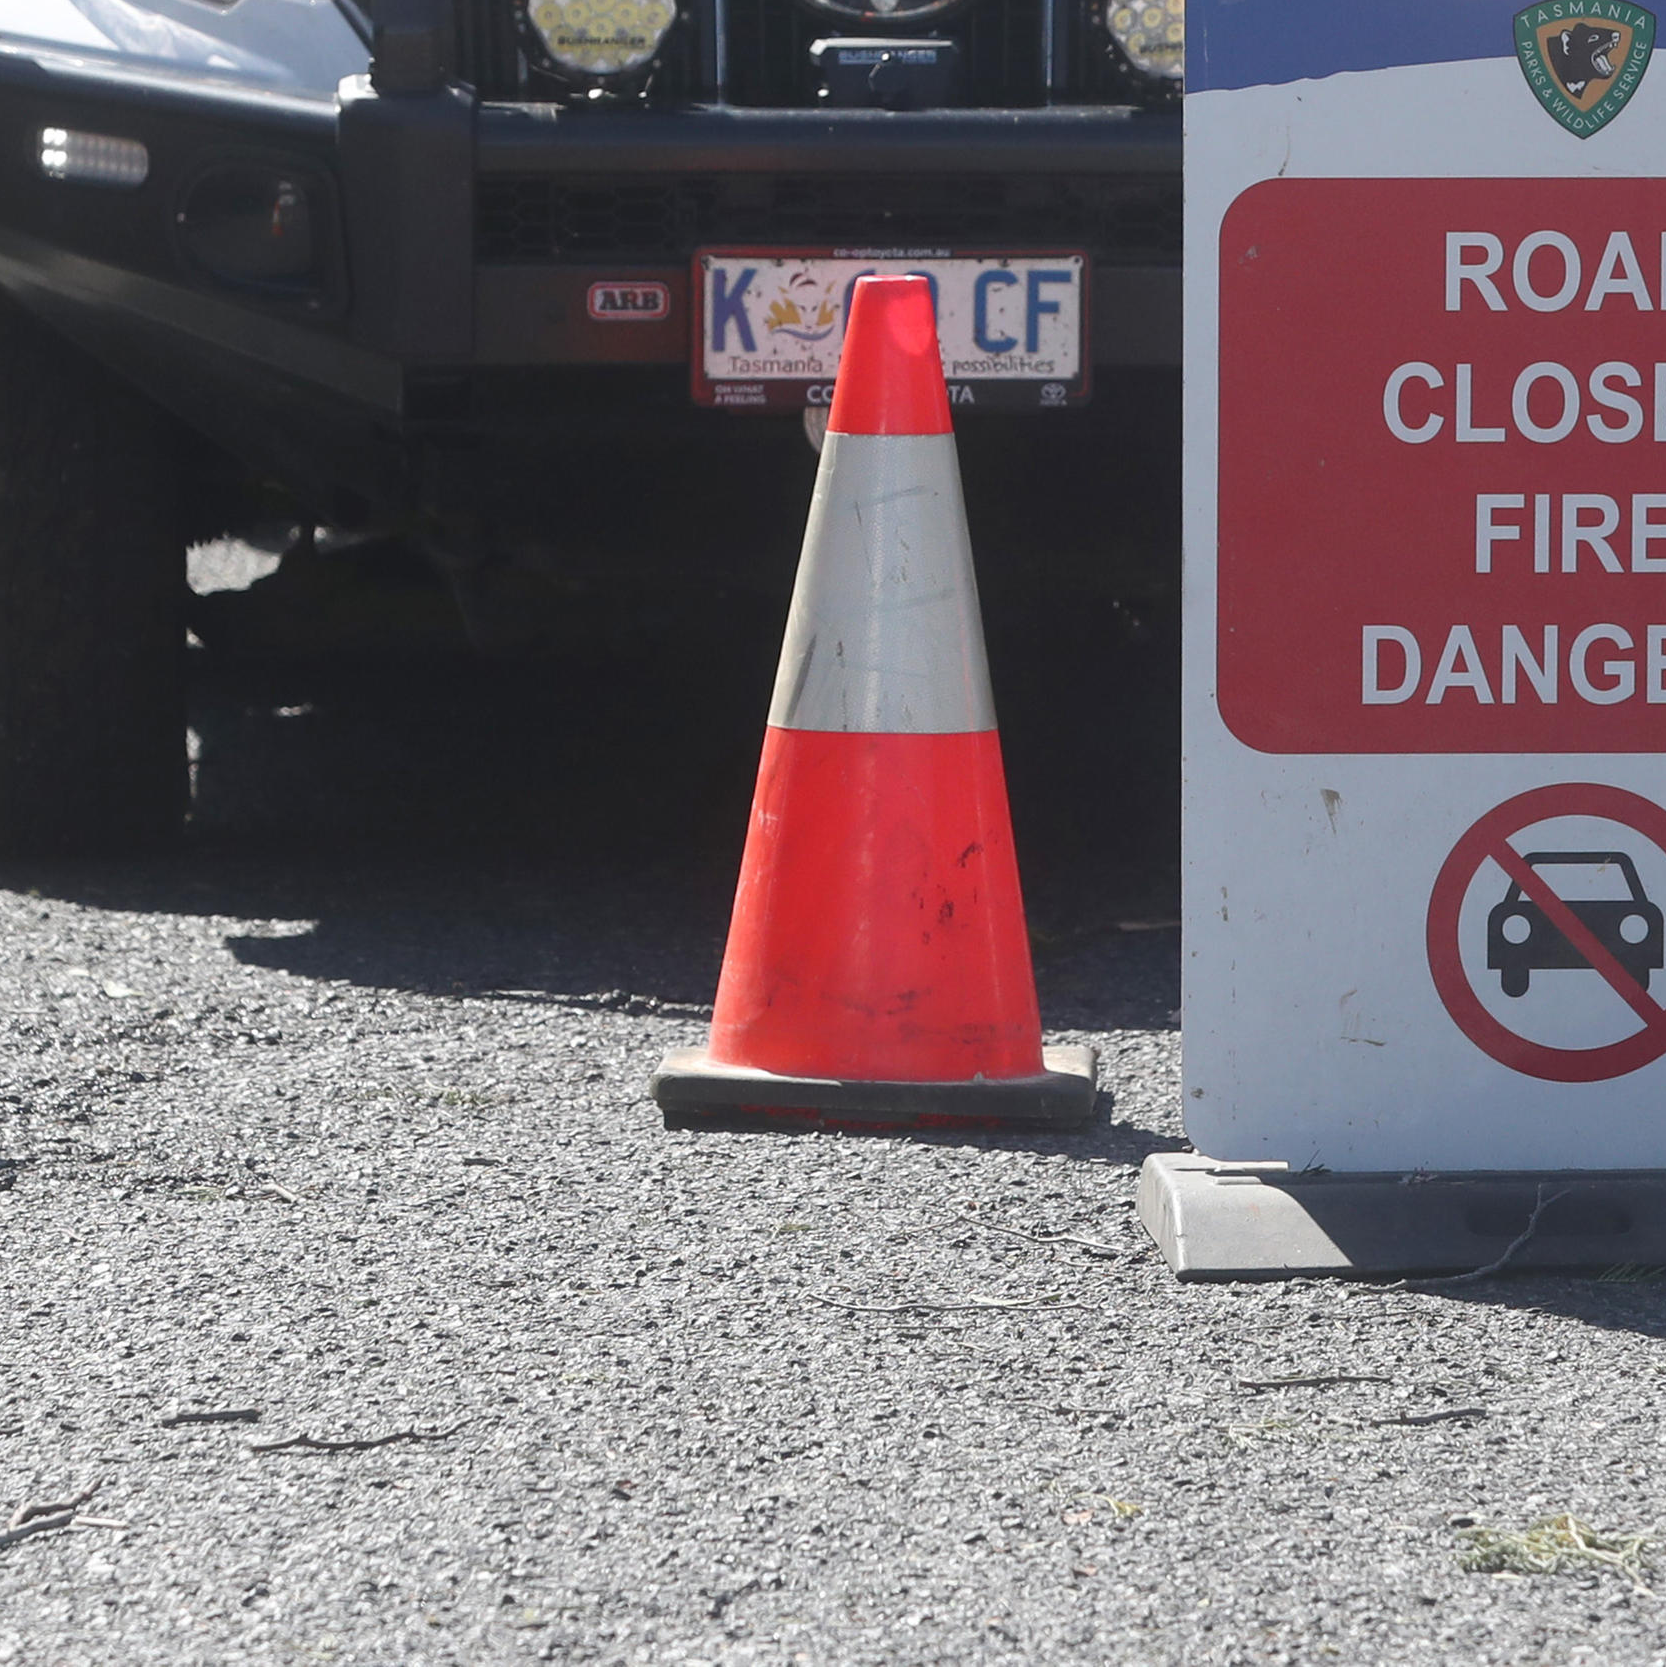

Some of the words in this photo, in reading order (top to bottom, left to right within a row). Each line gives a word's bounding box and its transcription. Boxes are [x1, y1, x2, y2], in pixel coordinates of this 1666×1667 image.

[1520, 1, 1646, 30] TASMANIA
[1521, 40, 1547, 86] PARKS
[1542, 87, 1553, 99] &
[1552, 97, 1615, 130] WILDLIFE
[1613, 41, 1647, 100] SERVICE
[598, 289, 660, 311] ARB
[712, 268, 758, 353] K
[973, 269, 1072, 353] CF
[729, 355, 823, 373] Tasmania
[952, 355, 1055, 375] possibilities
